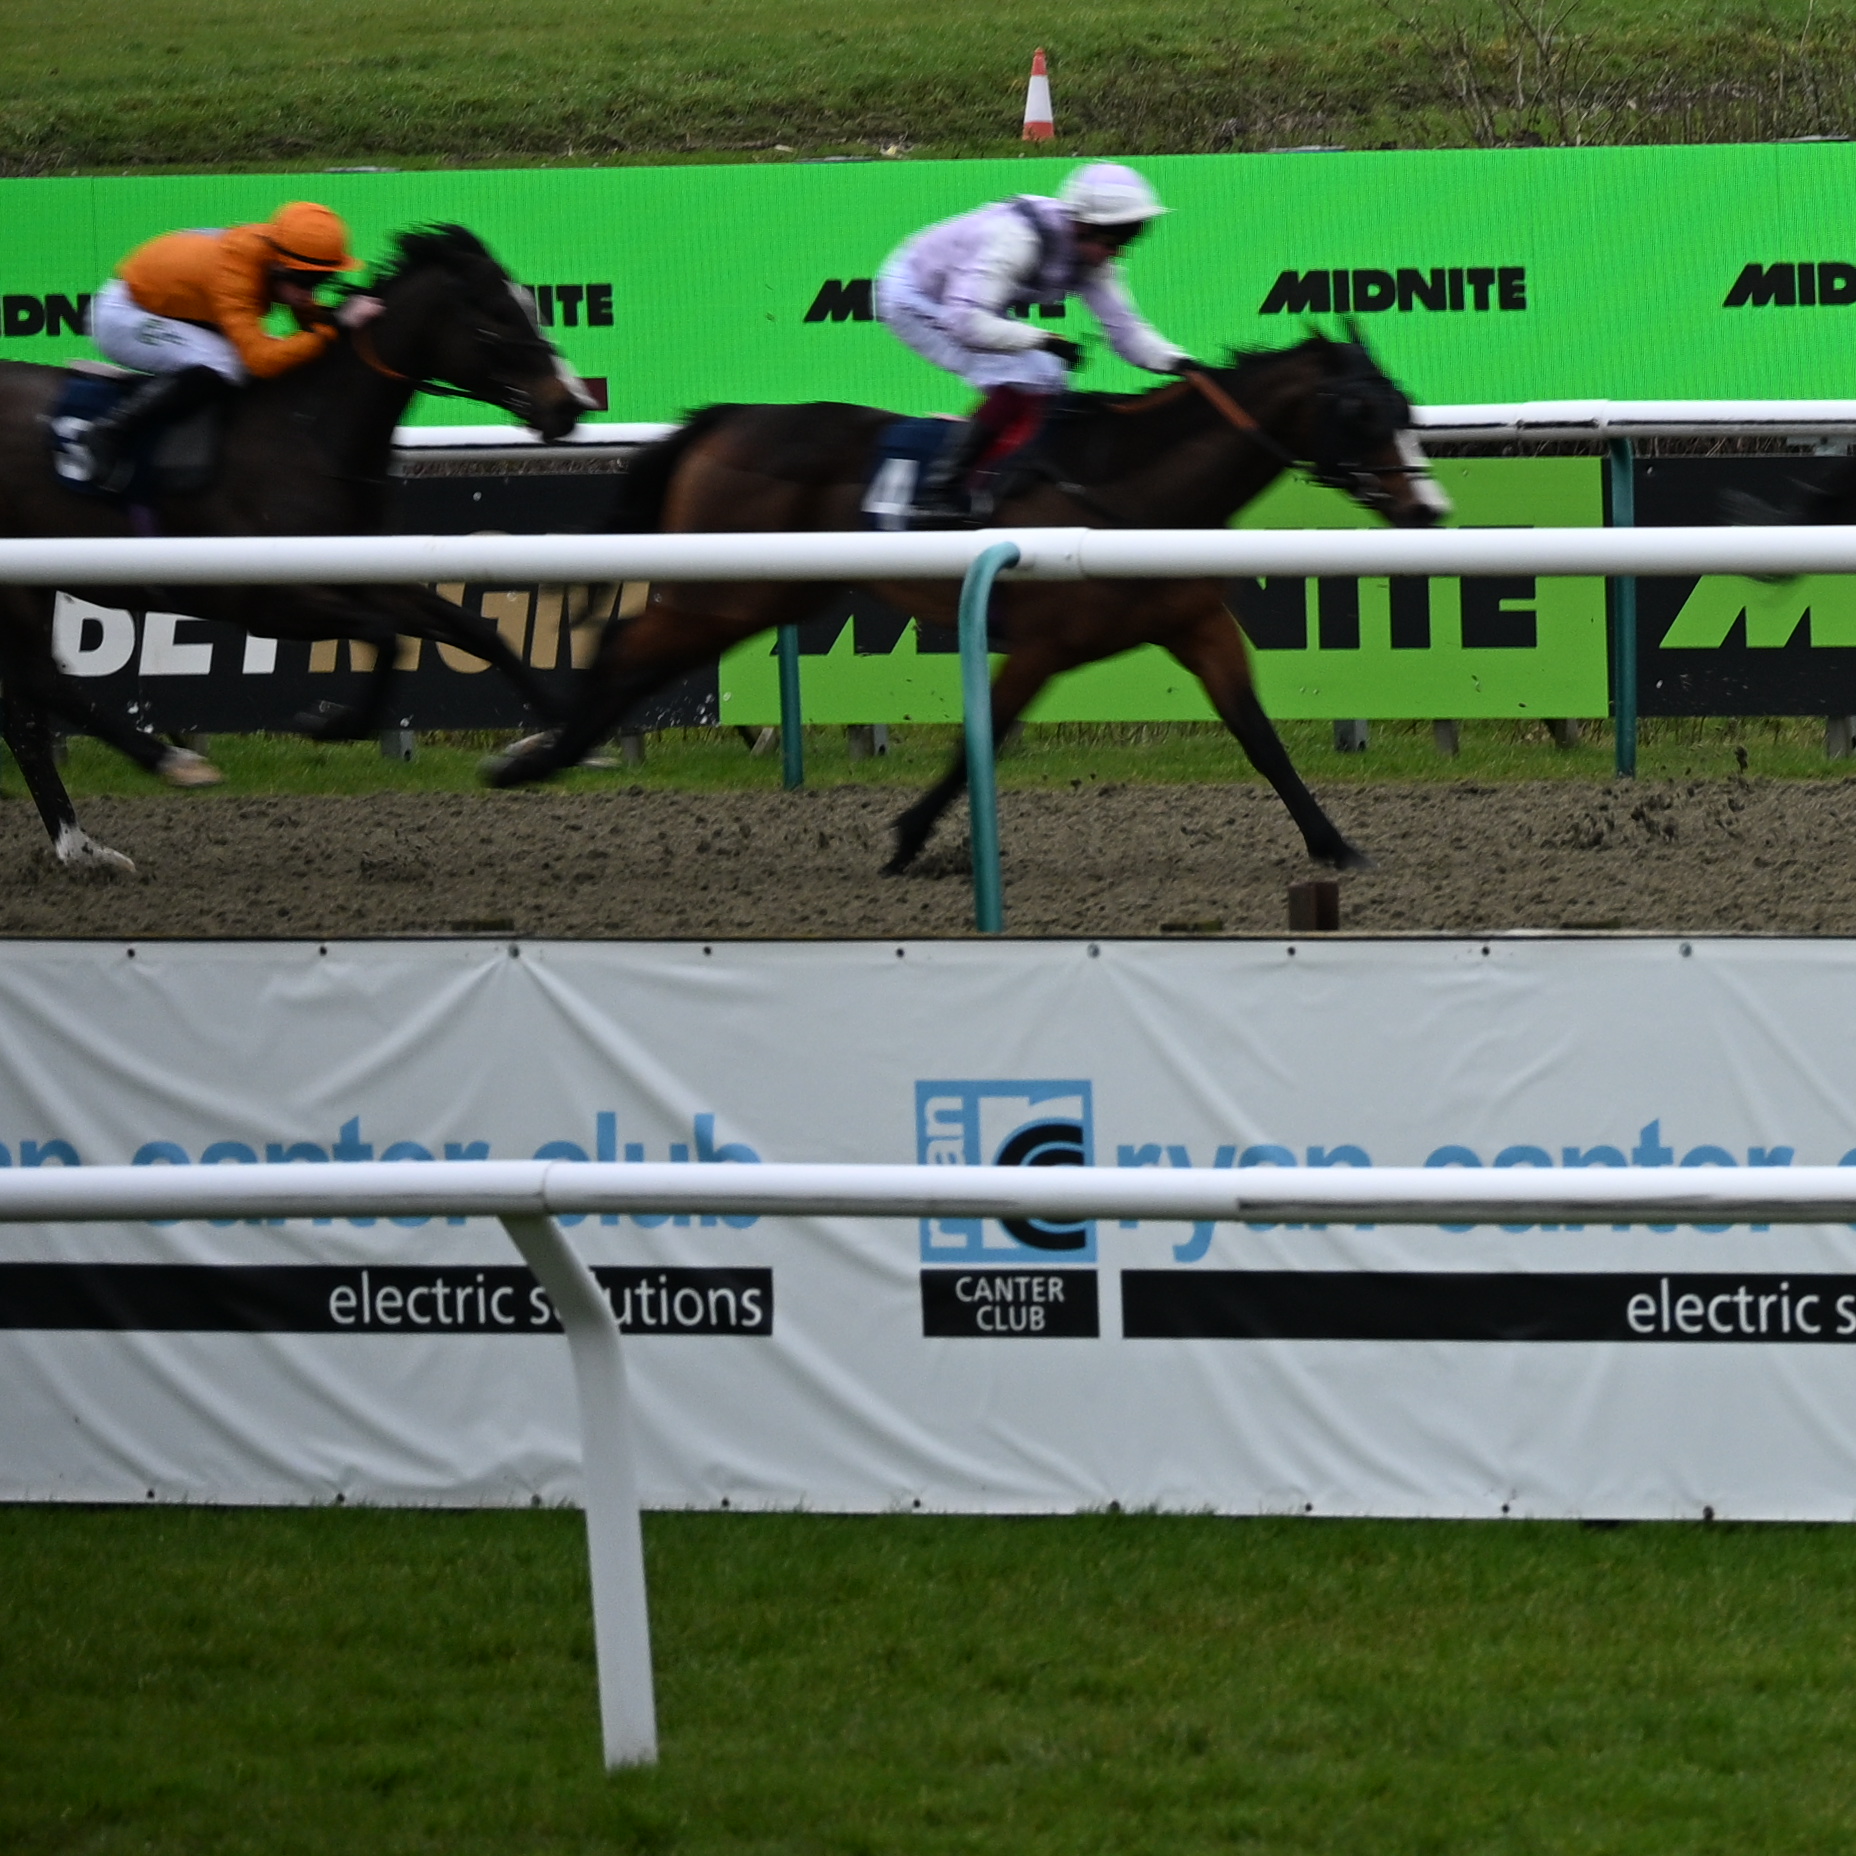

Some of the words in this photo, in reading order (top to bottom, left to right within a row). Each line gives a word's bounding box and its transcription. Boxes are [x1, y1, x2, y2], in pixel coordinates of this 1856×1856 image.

[1258, 267, 1527, 314] MIDNITE
[329, 1271, 515, 1326] electric
[530, 1271, 763, 1327] sutions
[955, 1276, 1065, 1303] CANTER
[1626, 1278, 1821, 1334] electric
[976, 1304, 1047, 1332] CLUB
